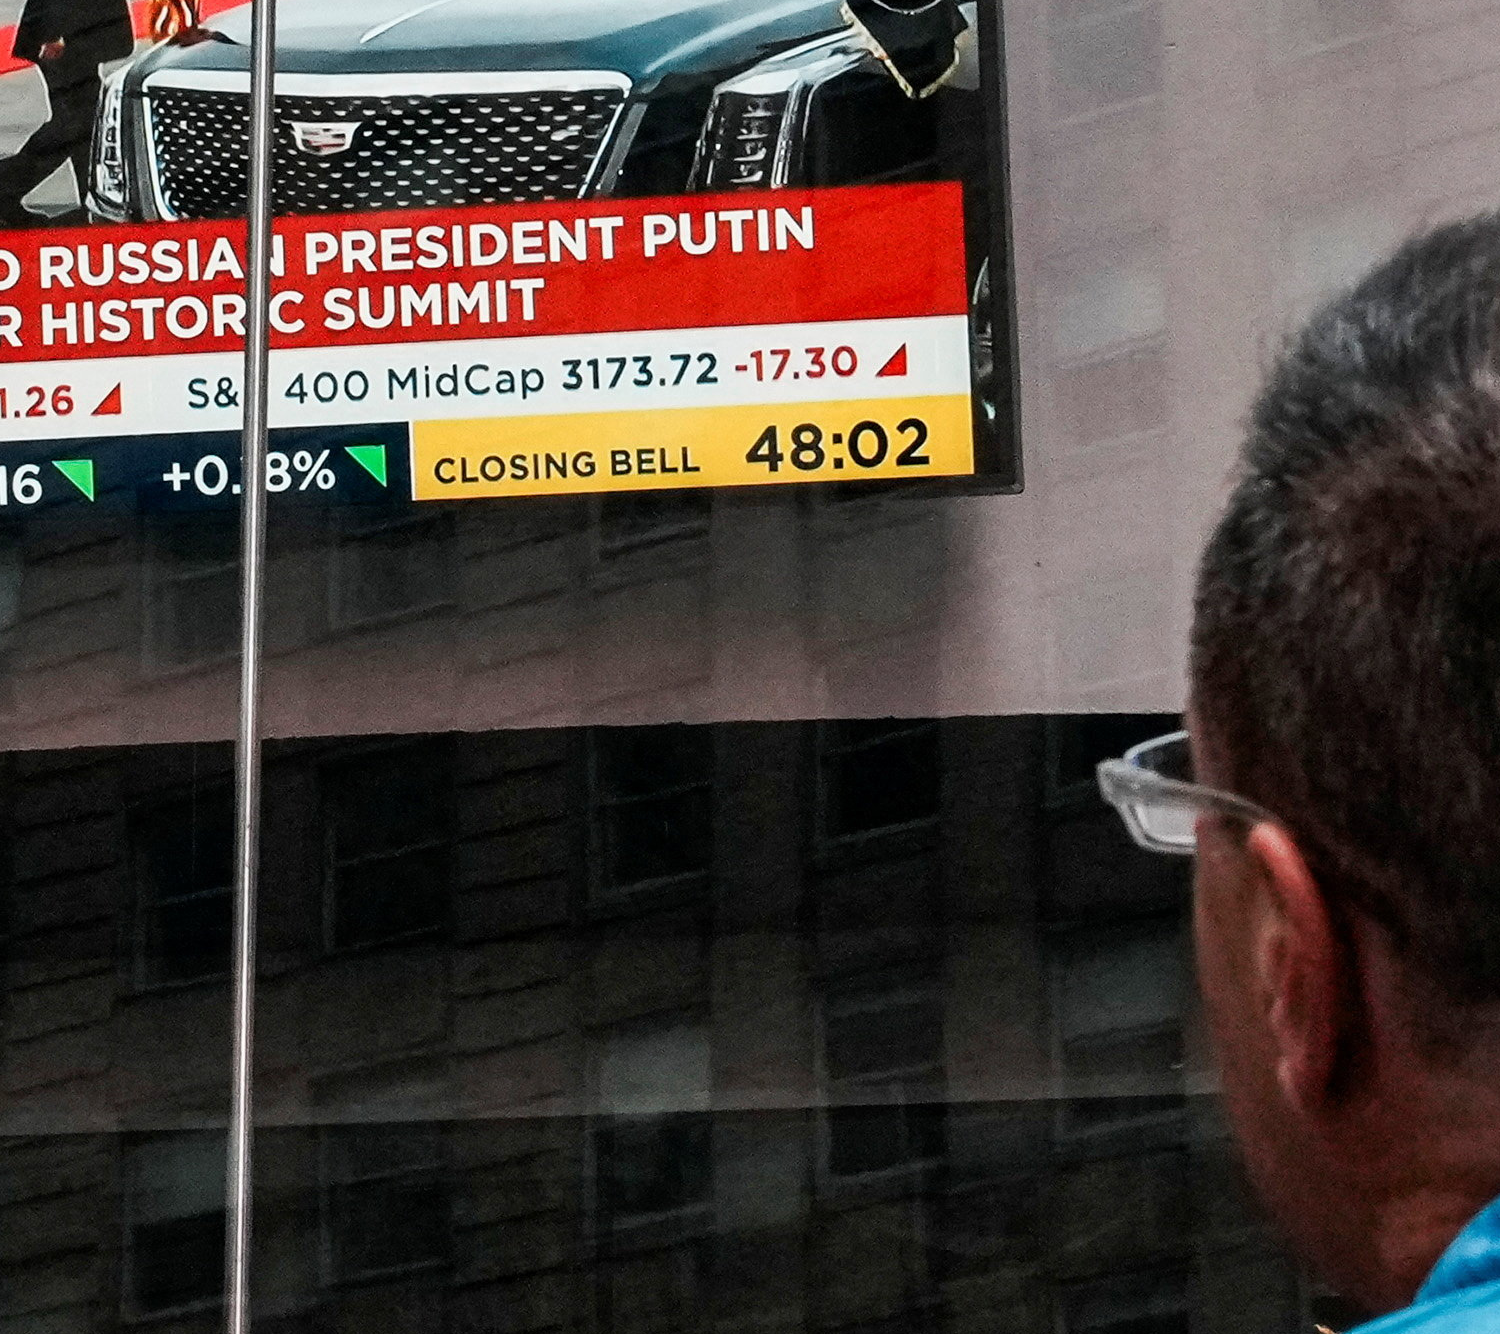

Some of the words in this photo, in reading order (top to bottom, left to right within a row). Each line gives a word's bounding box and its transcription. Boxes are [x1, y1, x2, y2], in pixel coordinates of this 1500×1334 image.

[306, 217, 623, 276] PRESIDENT
[642, 207, 814, 257] PUTIN
[42, 291, 304, 346] HISTORC
[324, 278, 544, 329] SUMMIT
[188, 376, 239, 410] S&
[284, 370, 369, 404] 400
[388, 361, 544, 400] MidCap
[562, 353, 718, 391] 3173.72
[735, 346, 857, 381] -17.30
[163, 448, 335, 494] +0.8%
[434, 451, 597, 483] CLOSING
[611, 447, 700, 475] BELL
[745, 420, 929, 473] 48:02
